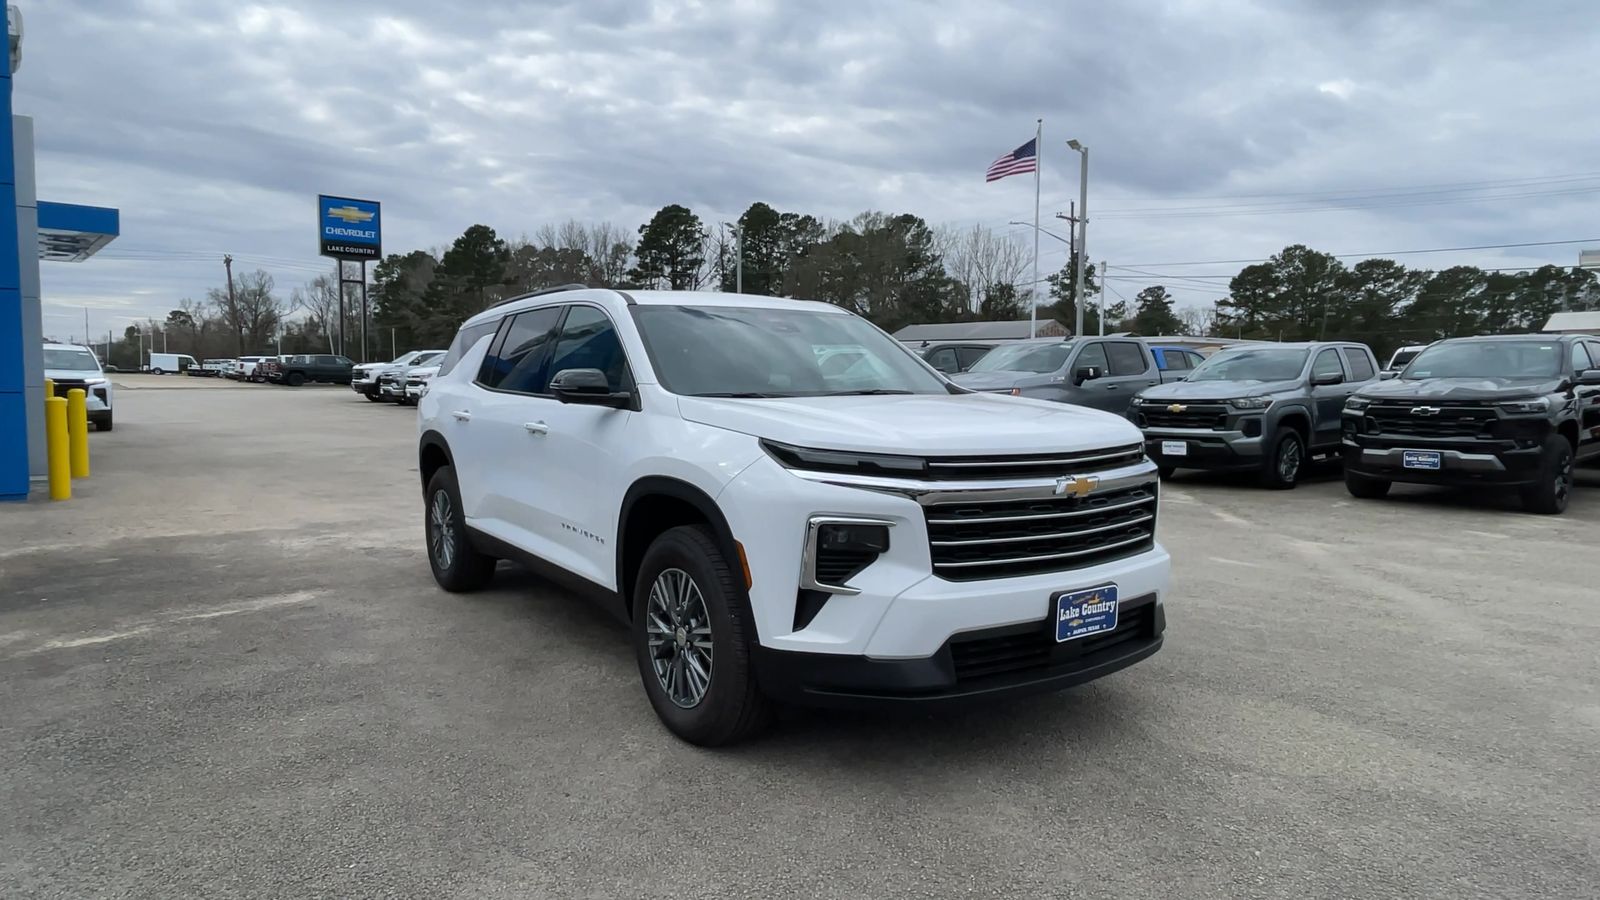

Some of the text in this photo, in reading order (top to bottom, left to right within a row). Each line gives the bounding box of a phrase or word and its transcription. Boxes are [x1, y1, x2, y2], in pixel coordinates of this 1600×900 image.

[325, 226, 376, 239] CHEVROLET
[345, 246, 375, 255] COUNTRY
[1060, 600, 1116, 621] Lake Country
